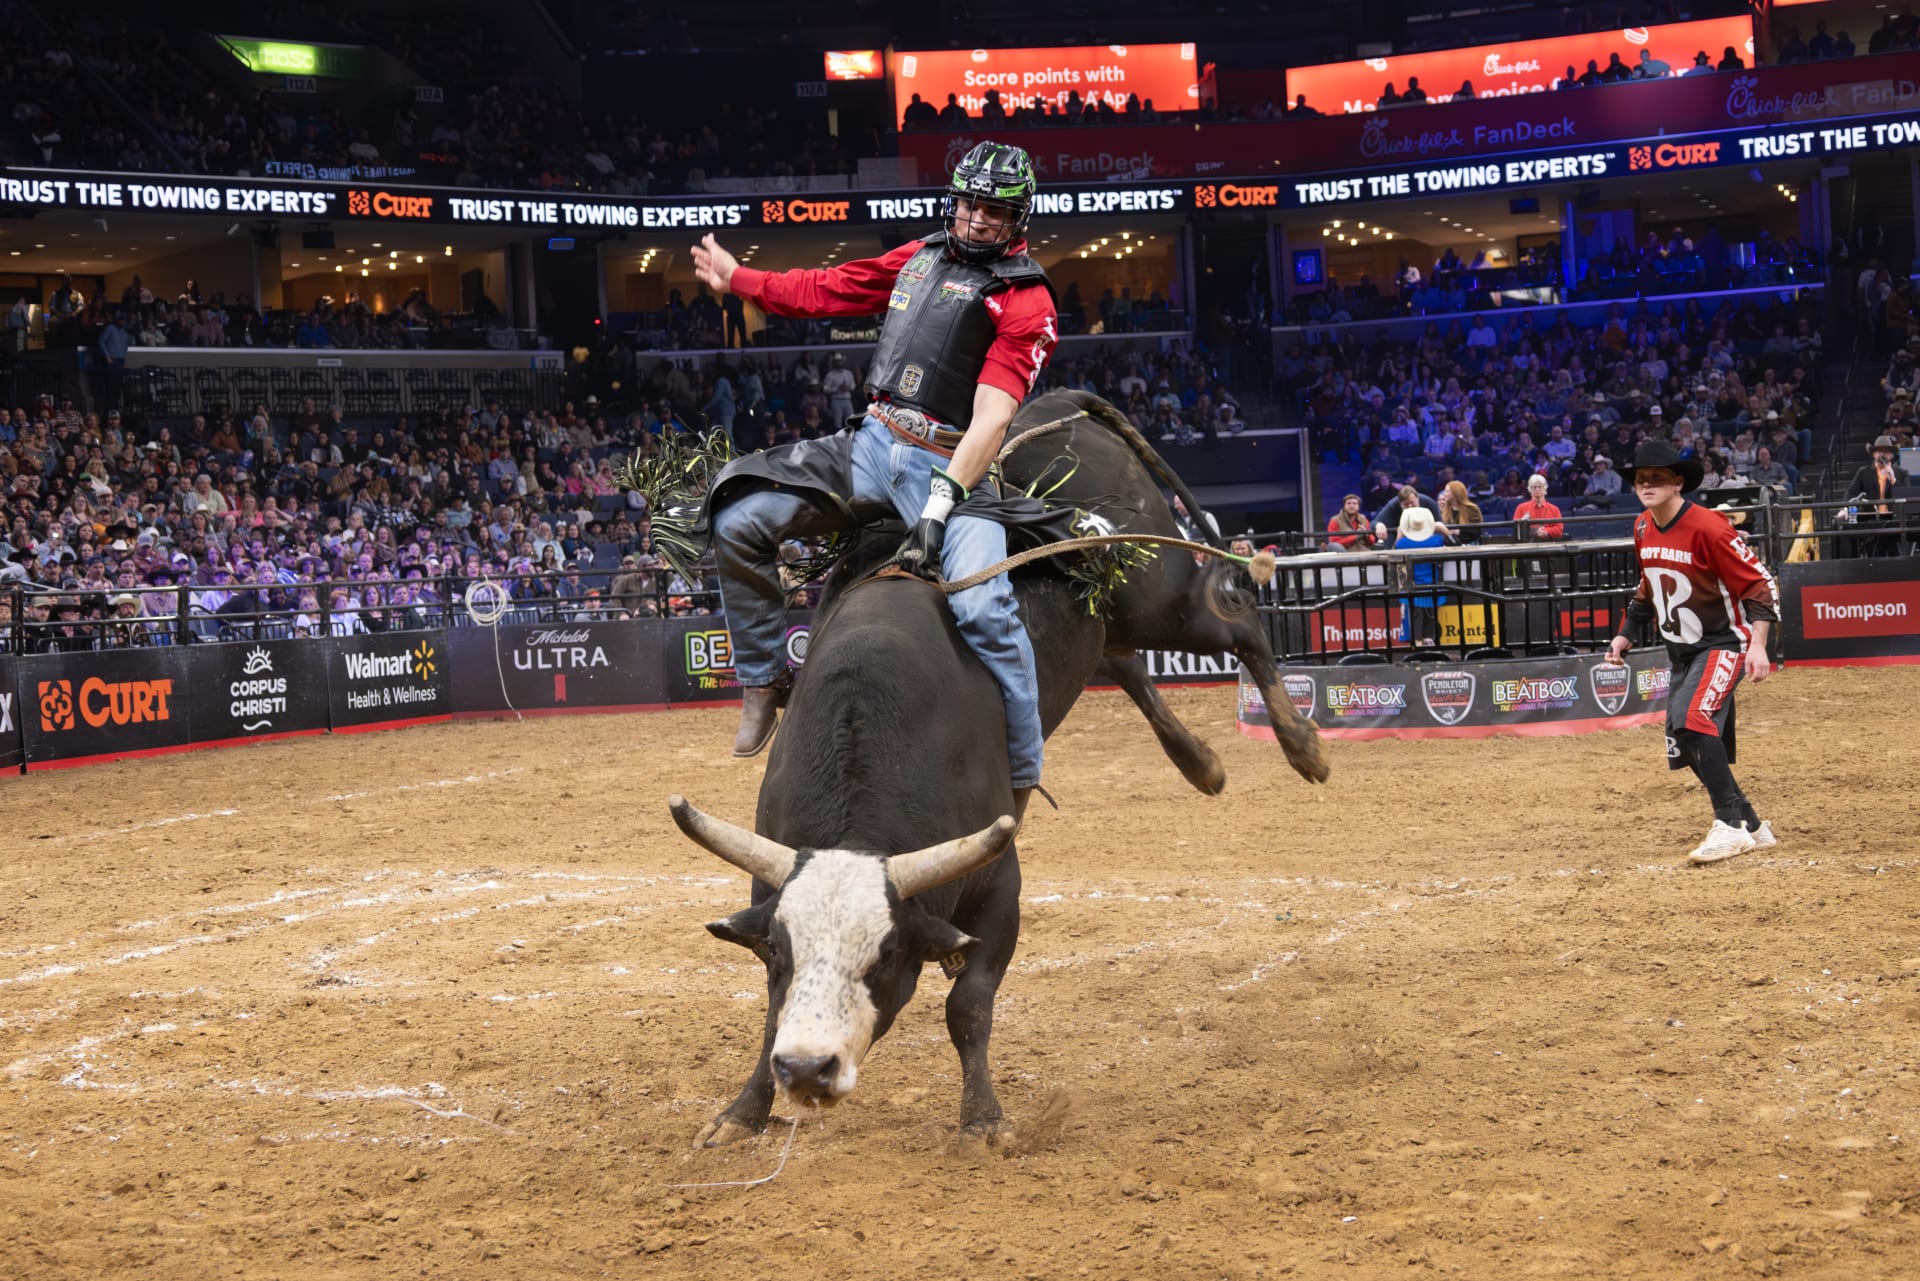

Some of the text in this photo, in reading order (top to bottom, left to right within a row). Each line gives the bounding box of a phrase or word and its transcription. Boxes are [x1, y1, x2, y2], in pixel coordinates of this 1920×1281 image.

[964, 66, 1125, 88] Score points with
[1474, 117, 1576, 145] FanDeck
[1739, 120, 1920, 159] TRUST THE TOW
[1057, 152, 1154, 174] FanDeck
[1655, 142, 1720, 167] CURT
[0, 177, 70, 204] TRUST
[75, 182, 123, 206] THE
[127, 184, 221, 210] TOWING
[1219, 185, 1278, 207] CURT
[1295, 178, 1364, 204] TRUST
[1368, 173, 1411, 197] THE
[1413, 166, 1500, 191] TOWING
[373, 191, 432, 218] CURT
[449, 198, 513, 222] TRUST
[518, 201, 558, 224] THE
[562, 203, 639, 226] TOWING
[788, 200, 849, 223] CURT
[867, 198, 937, 220] TRUST
[1661, 547, 1692, 565] BARN
[1814, 601, 1907, 621] Thompson
[526, 628, 591, 646] Michelob
[345, 649, 413, 679] Walmart
[513, 646, 609, 670] ULTRA
[1137, 649, 1240, 676] TRIKE
[1429, 680, 1469, 690] PENDLETON
[1596, 669, 1627, 681] PENDLETON
[230, 677, 287, 697] CORPUS
[347, 685, 436, 709] Health & Wellness
[1329, 686, 1403, 706] BEATBOX
[1496, 680, 1575, 701] BEATBOX
[79, 676, 173, 728] CURT
[230, 697, 286, 717] CHRISTI
